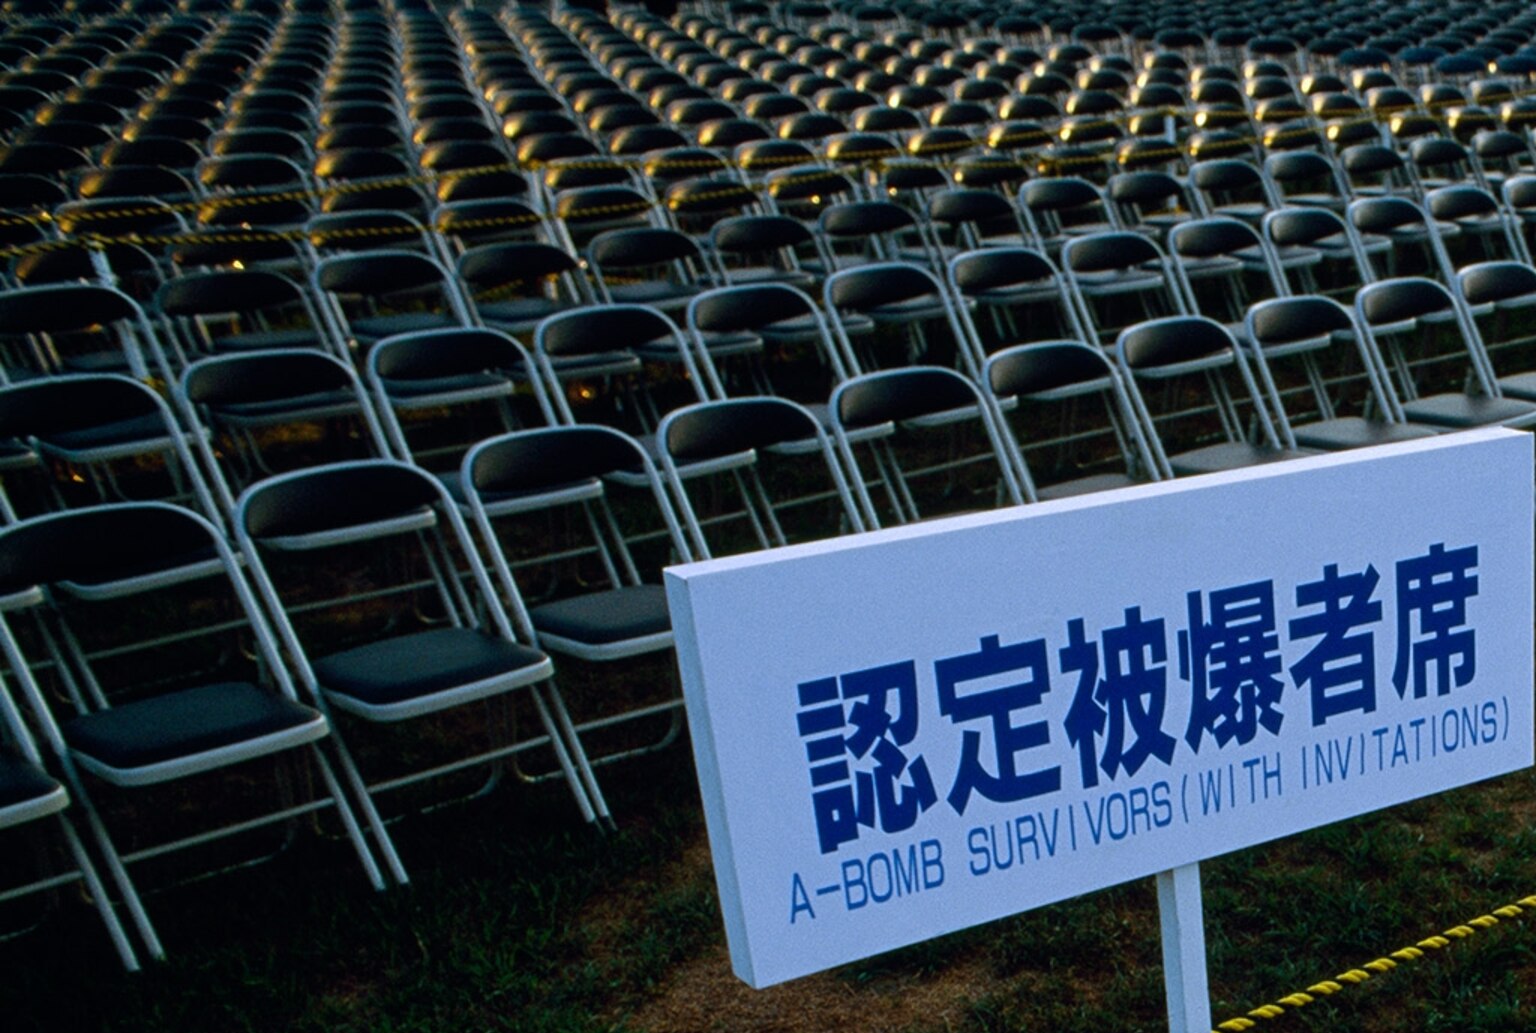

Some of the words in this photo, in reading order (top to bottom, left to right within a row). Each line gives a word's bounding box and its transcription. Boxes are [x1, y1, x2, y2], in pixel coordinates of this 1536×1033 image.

[789, 837, 946, 925] A-BOMB
[1300, 694, 1510, 791] INVITATIONS)
[796, 543, 1480, 856] 認定被爆者席
